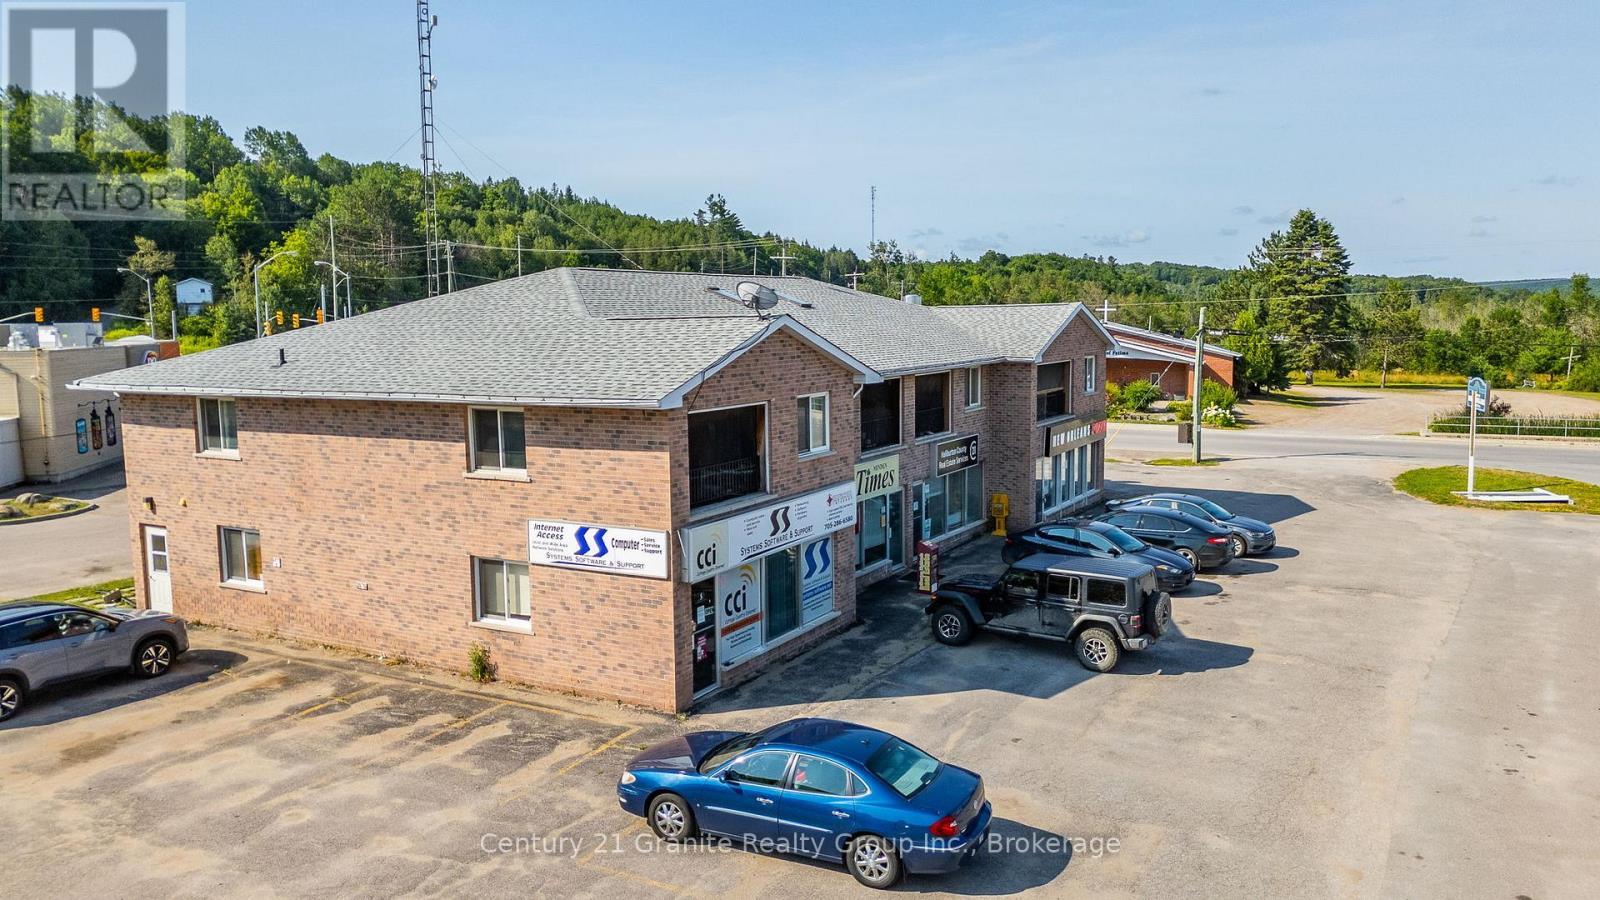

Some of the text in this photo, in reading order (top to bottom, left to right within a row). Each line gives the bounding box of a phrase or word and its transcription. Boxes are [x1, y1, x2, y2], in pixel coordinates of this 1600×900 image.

[856, 469, 895, 496] Times
[534, 523, 564, 533] Internet
[536, 531, 564, 540] Access
[611, 538, 640, 551] Computer
